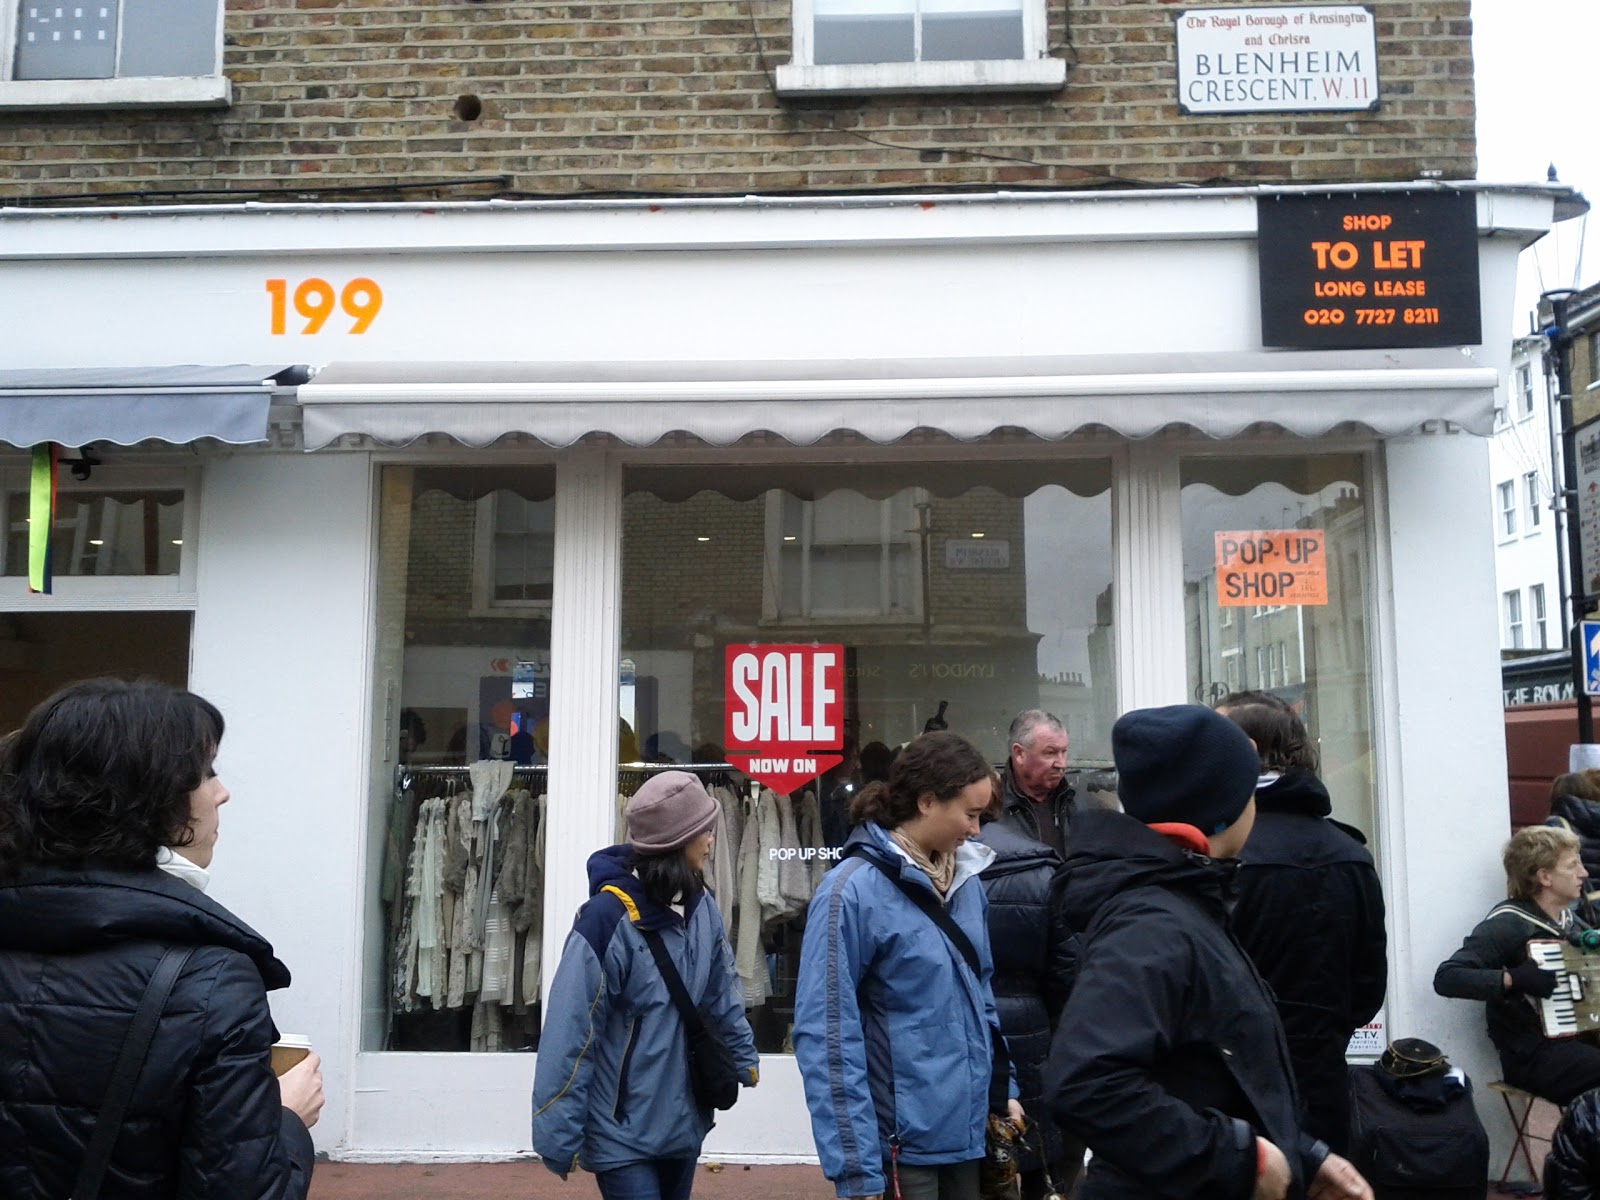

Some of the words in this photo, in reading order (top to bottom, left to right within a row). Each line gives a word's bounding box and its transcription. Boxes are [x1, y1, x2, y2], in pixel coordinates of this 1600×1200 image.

[1186, 16, 1206, 29] The
[1211, 15, 1241, 30] Royal
[1246, 14, 1288, 27] Borough
[1293, 12, 1304, 25] of
[1309, 11, 1367, 26] Kensington
[1244, 34, 1263, 46] and
[1268, 33, 1310, 45] Chelsea
[1196, 51, 1361, 75] BLENHEIM
[1343, 215, 1392, 231] SHOP
[1311, 241, 1359, 270] TO
[1373, 240, 1426, 269] LET
[1314, 281, 1366, 297] LONG
[1374, 280, 1426, 296] LEASE
[265, 276, 383, 335] 199
[1304, 308, 1345, 325] 020
[1355, 308, 1396, 325] 7727
[1403, 308, 1439, 324] 8211
[1225, 571, 1295, 598] SHOP
[732, 652, 836, 742] SALE
[750, 758, 789, 773] NOW
[793, 758, 817, 773] ON
[769, 848, 797, 861] POP
[799, 848, 817, 860] UP
[818, 847, 843, 860] SHO
[1353, 1031, 1379, 1039] C.T.V.
